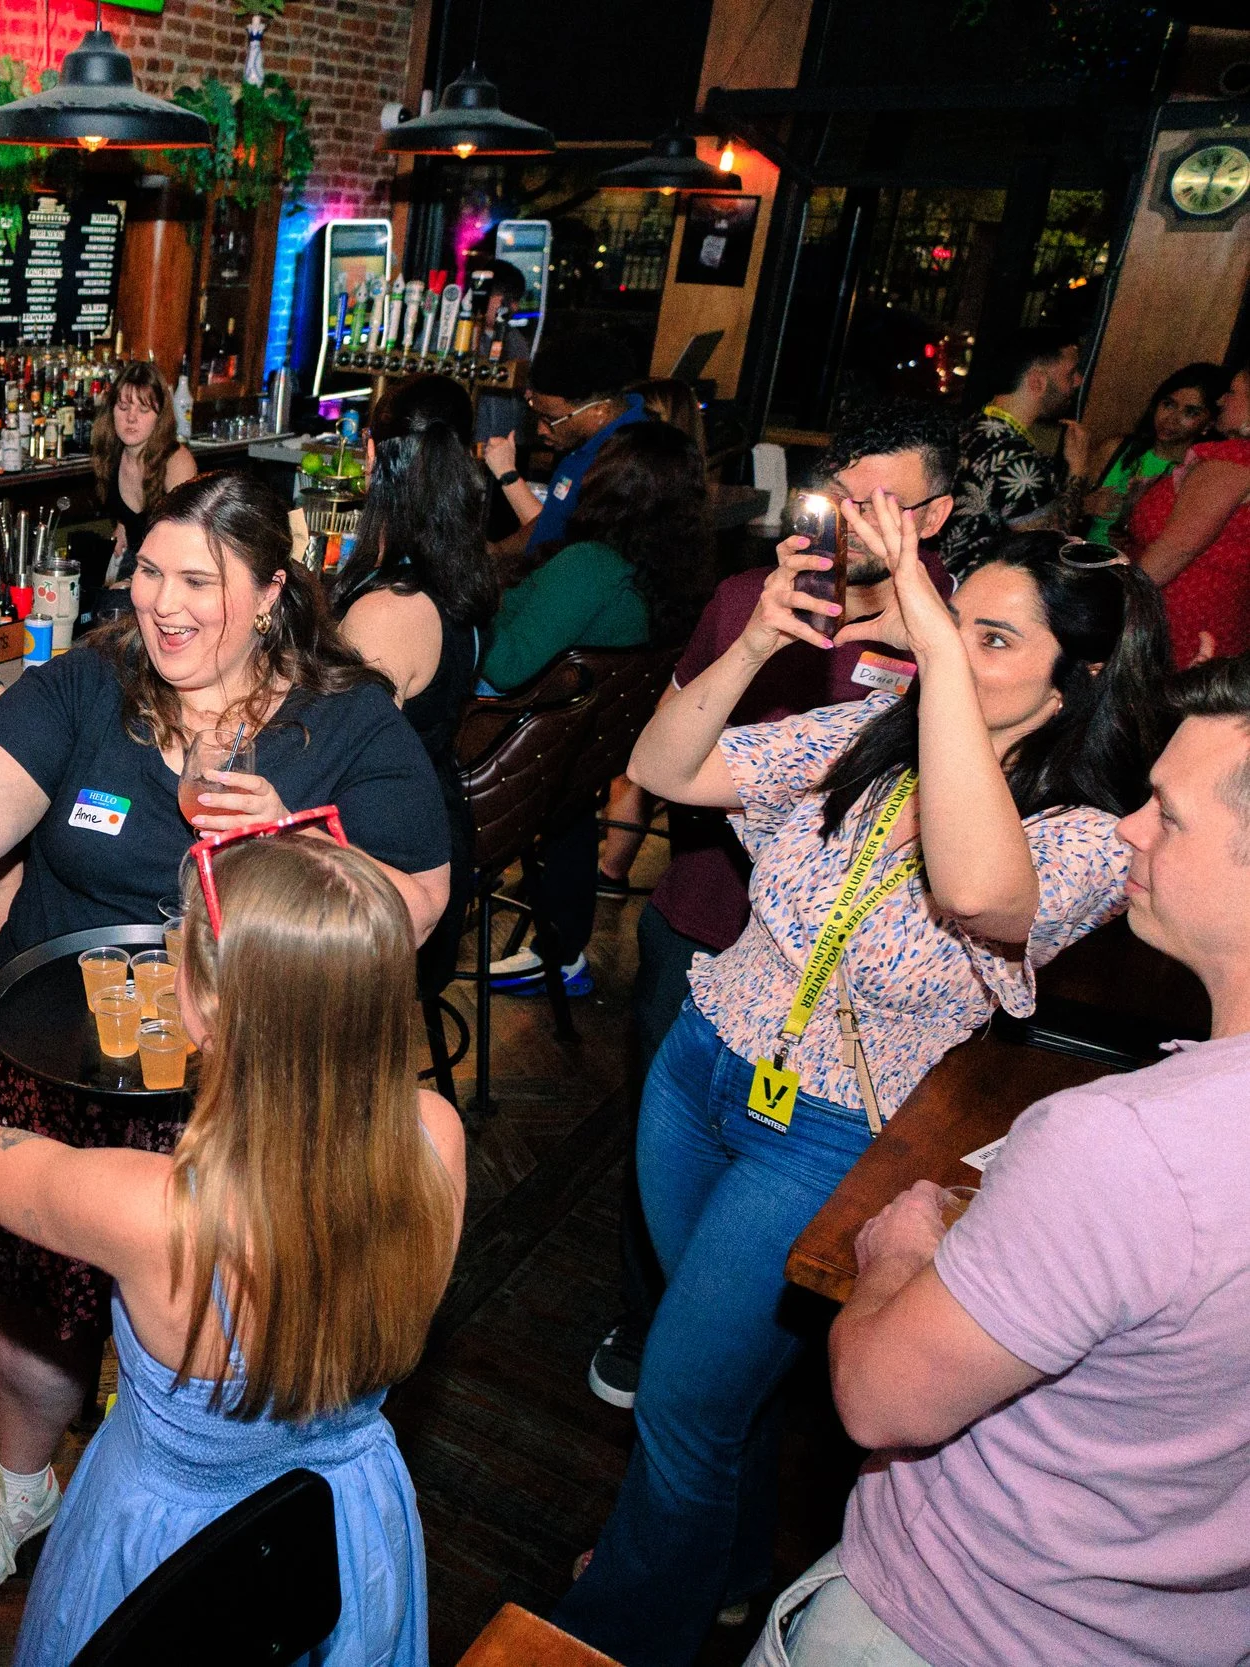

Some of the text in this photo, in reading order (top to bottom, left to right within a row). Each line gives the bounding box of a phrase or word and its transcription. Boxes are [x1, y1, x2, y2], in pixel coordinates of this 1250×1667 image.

[859, 668, 900, 687] Daniel
[89, 791, 118, 805] HELLO
[73, 806, 102, 824] Anne
[838, 839, 880, 908] VOLUNTEER
[845, 872, 905, 932] VOLUNTEER
[800, 946, 841, 1009] VOLUNTEER
[747, 1108, 788, 1134] VOLUNTEER
